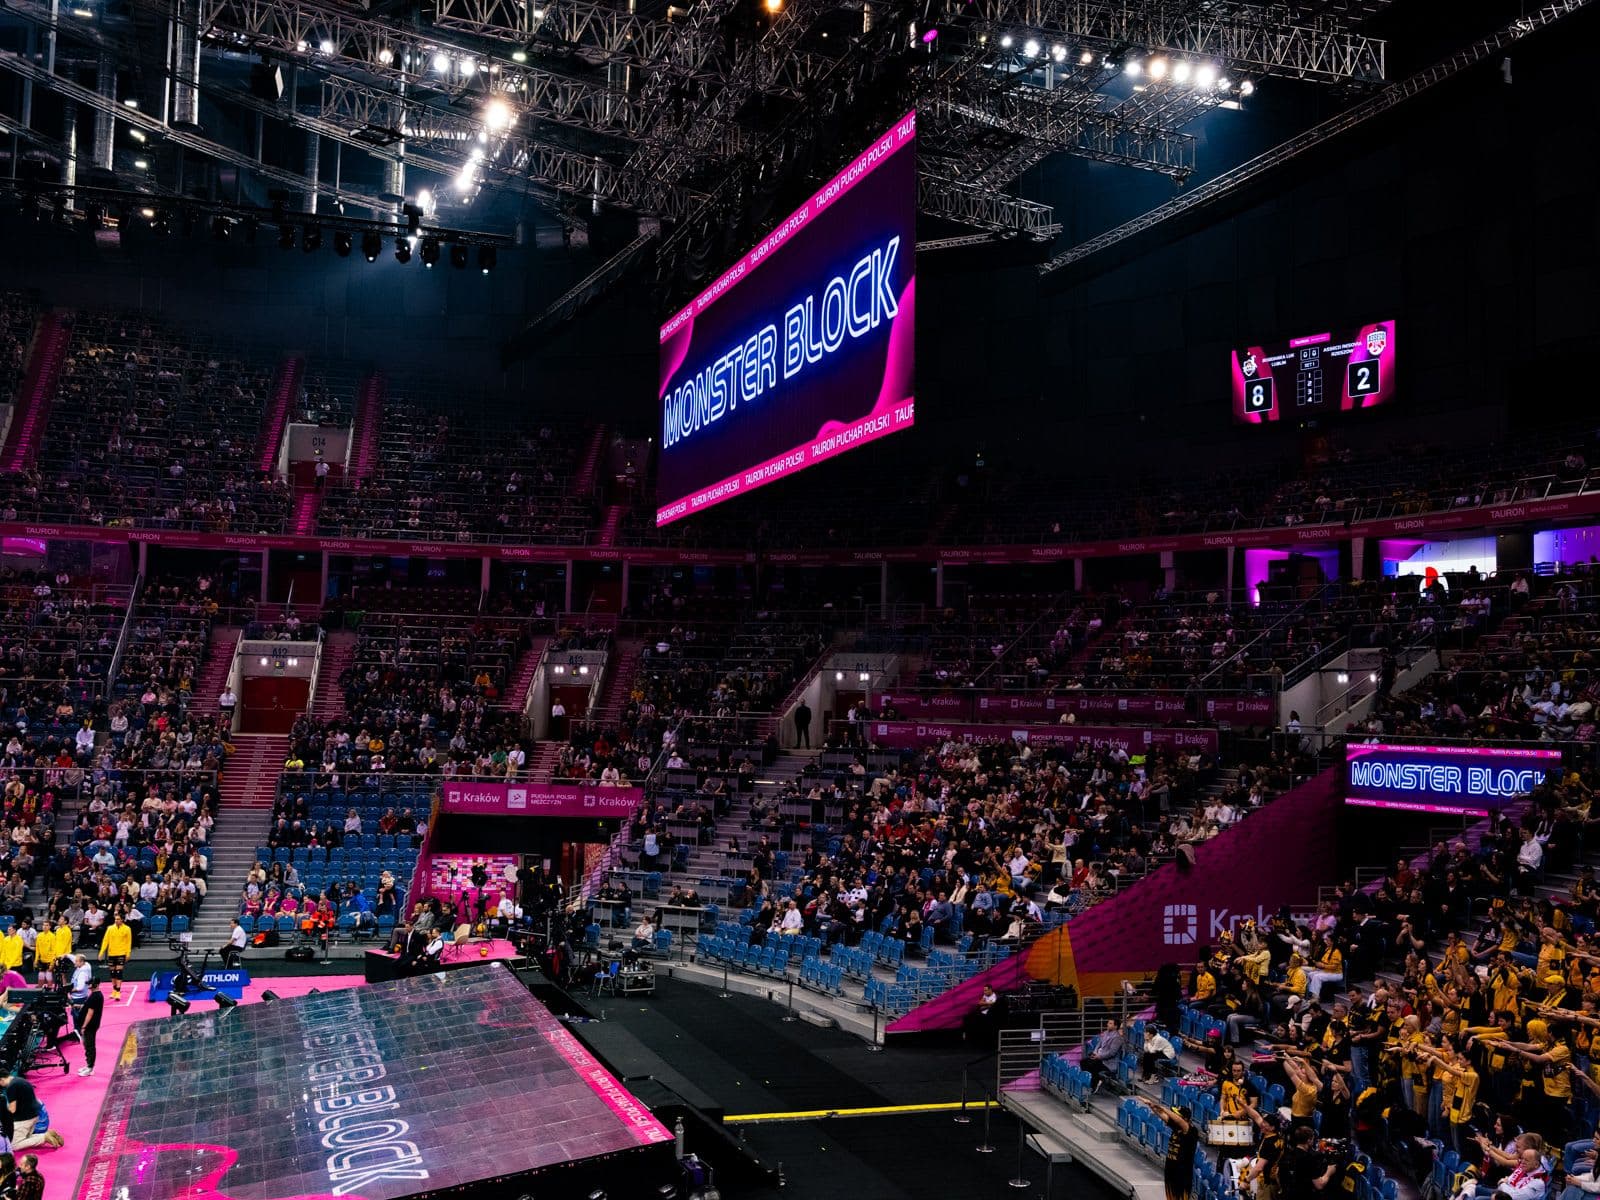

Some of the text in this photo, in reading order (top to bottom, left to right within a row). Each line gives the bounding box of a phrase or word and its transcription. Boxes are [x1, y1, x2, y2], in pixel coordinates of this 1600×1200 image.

[815, 135, 893, 209] TAURON PUCHAR POLSKI
[750, 206, 809, 265] TAURON PUCHAR POLSKI
[663, 235, 900, 449] MONSTER BLOCK
[1357, 367, 1371, 391] 2
[1252, 385, 1264, 407] 8
[811, 413, 890, 457] TAURON PUCHAR POLSKI
[745, 450, 805, 486] TAURON PUCHAR POLSKI
[1489, 506, 1526, 520] TAURON
[1392, 518, 1425, 531] TAURON
[25, 526, 60, 536] TAURON
[127, 532, 161, 541] TAURON
[1297, 528, 1330, 539] TAURON
[225, 536, 257, 546] TAURON
[319, 541, 351, 550] TAURON
[1203, 535, 1233, 545] TAURON
[500, 548, 530, 557] TAURON
[931, 697, 960, 707] Kraków
[1351, 761, 1462, 793] MONSTER
[463, 792, 501, 804] Kraków
[598, 796, 636, 807] Kraków
[200, 973, 240, 984] ATHLON
[313, 1084, 431, 1197] BLOCK
